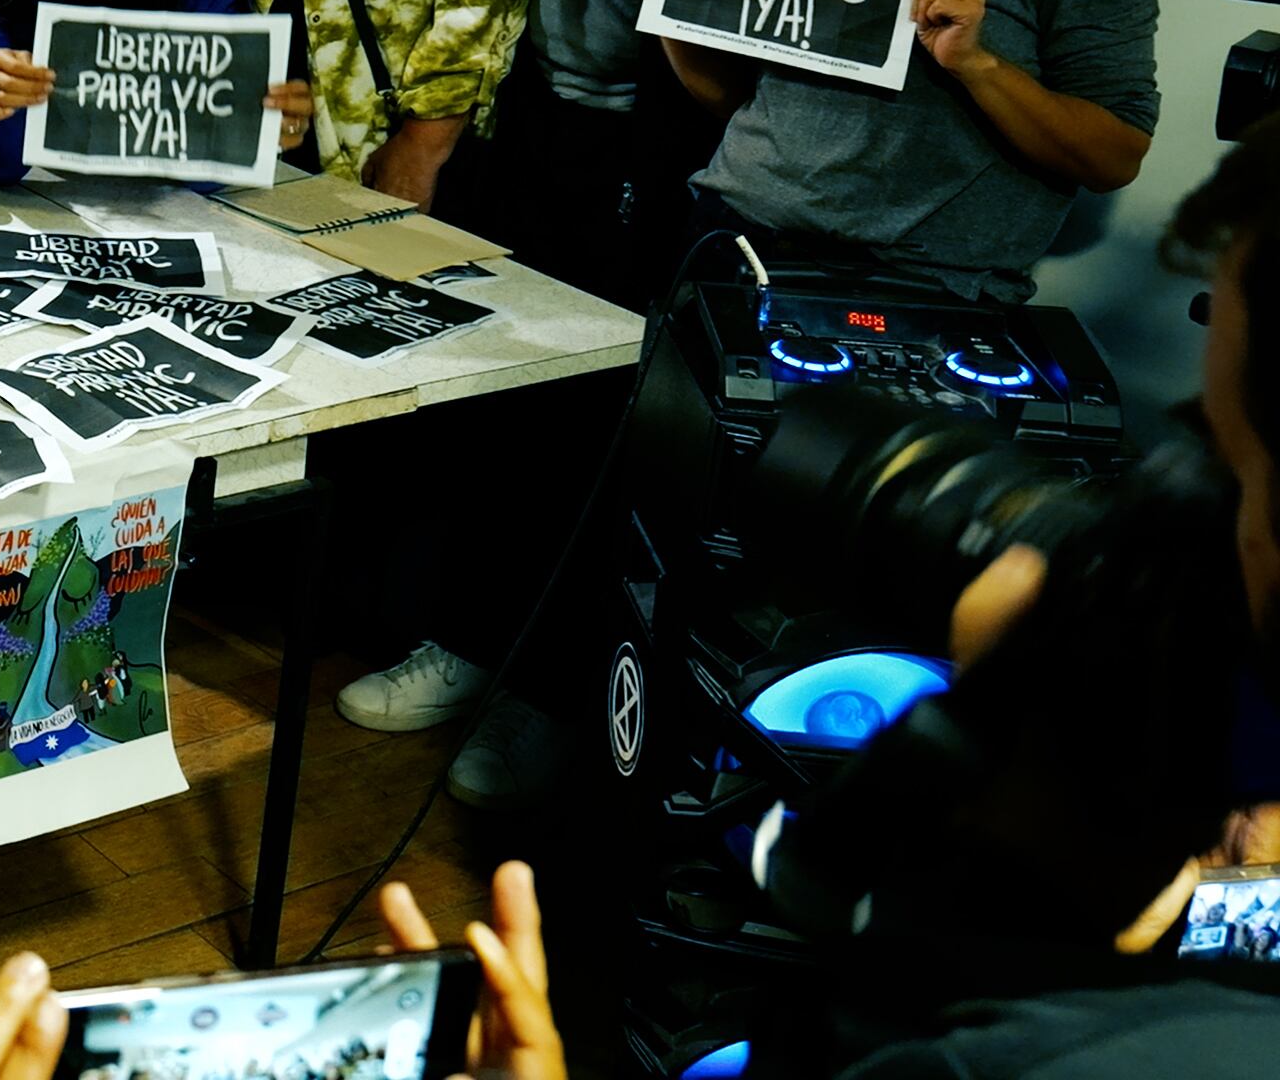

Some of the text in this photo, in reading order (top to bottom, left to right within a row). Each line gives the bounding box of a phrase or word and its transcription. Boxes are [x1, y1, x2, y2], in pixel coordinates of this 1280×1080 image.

[76, 71, 235, 117] PARA VIC
[119, 108, 188, 163] ¡YA!
[184, 311, 249, 342] VIC
[17, 527, 34, 546] DE
[155, 515, 165, 535] A
